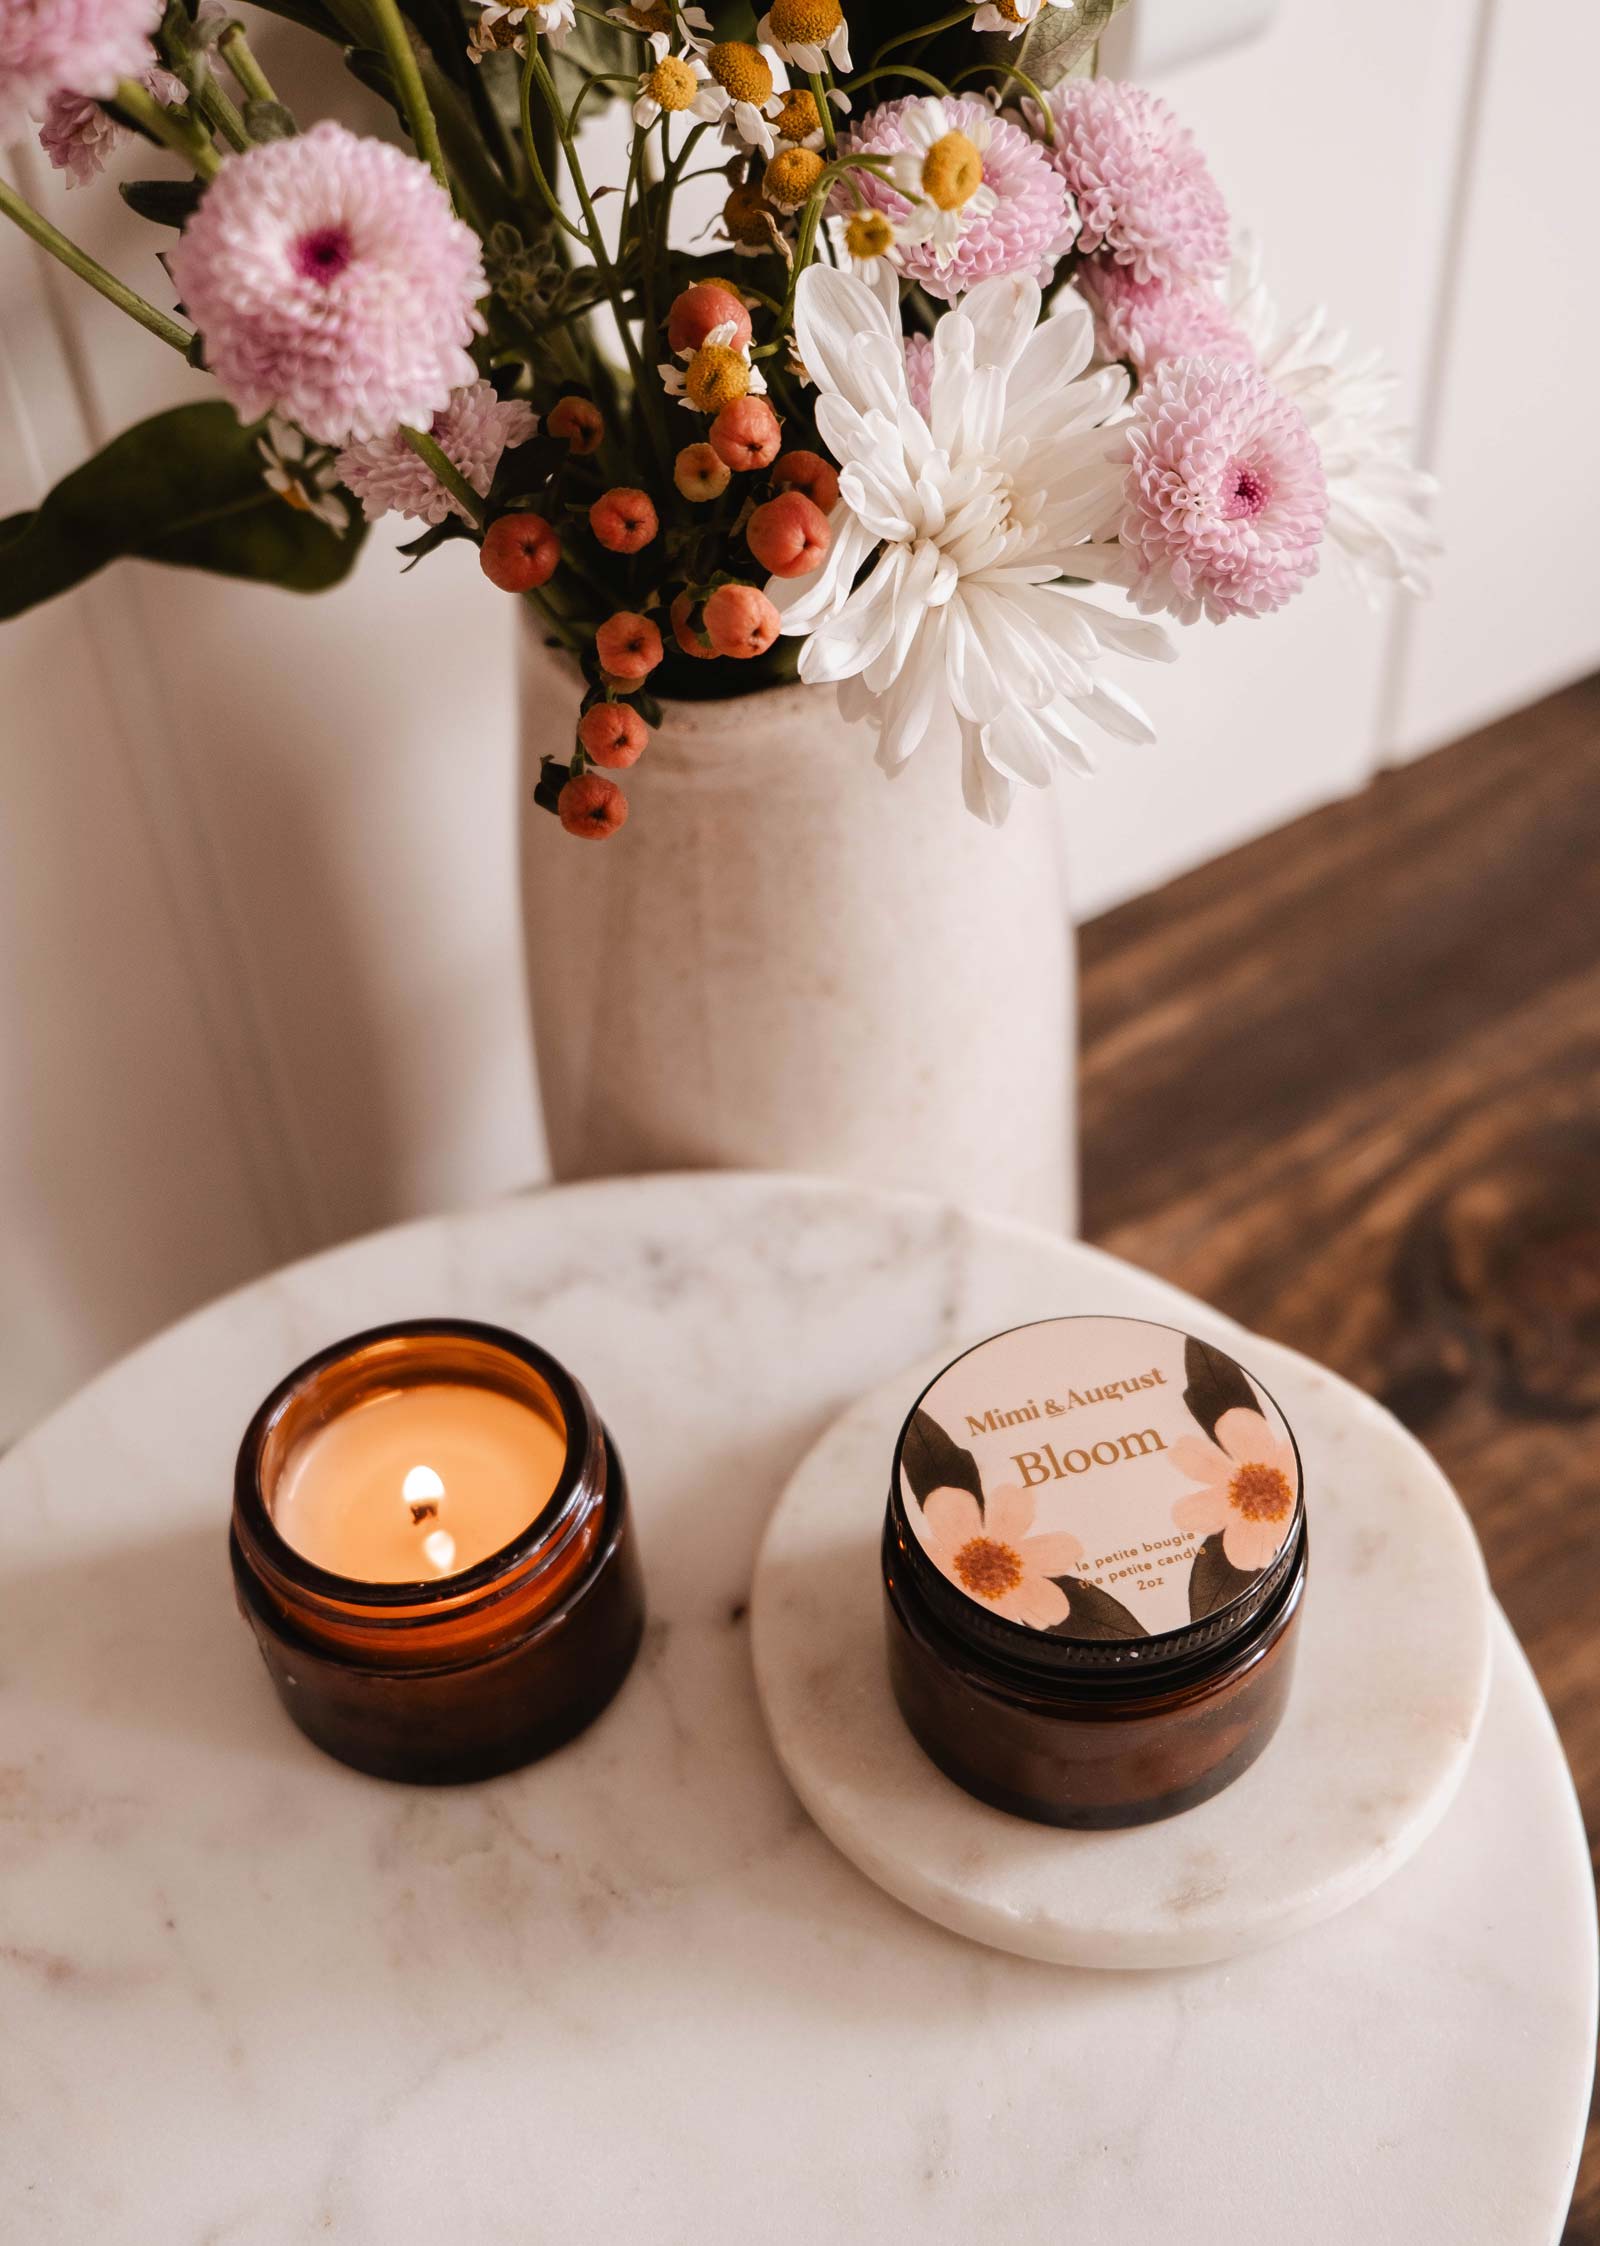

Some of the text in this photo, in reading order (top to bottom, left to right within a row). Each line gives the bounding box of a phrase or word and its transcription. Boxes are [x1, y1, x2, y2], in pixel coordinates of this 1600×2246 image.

[965, 1399, 1041, 1437] Mimi
[1067, 1367, 1168, 1410] August
[1009, 1427, 1169, 1488] Bloom
[1075, 1531, 1195, 1572] la petite bougie
[1108, 1561, 1152, 1583] petite
[1157, 1546, 1207, 1567] candle
[1136, 1576, 1165, 1591] 2oz
